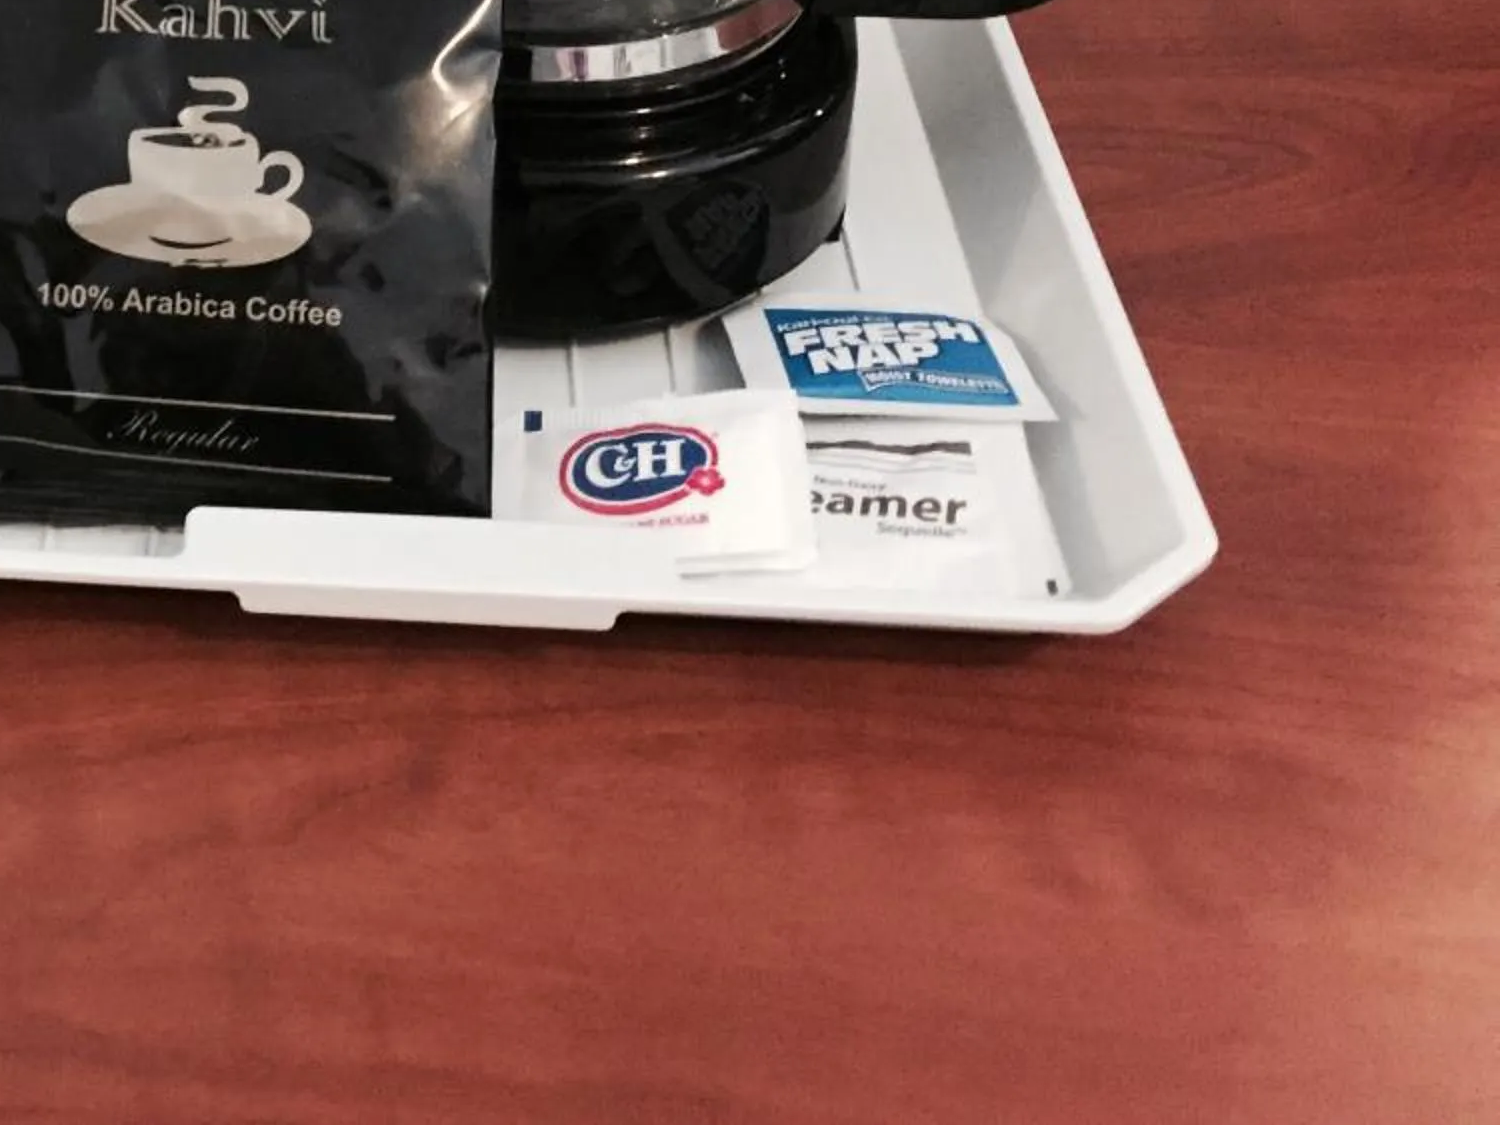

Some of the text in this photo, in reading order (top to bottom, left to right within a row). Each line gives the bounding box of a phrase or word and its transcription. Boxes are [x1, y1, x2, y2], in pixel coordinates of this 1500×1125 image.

[37, 282, 343, 327] 100% Arabica Coffee
[782, 319, 981, 356] FRESH
[807, 341, 940, 375] NAP
[584, 438, 687, 489] C&H
